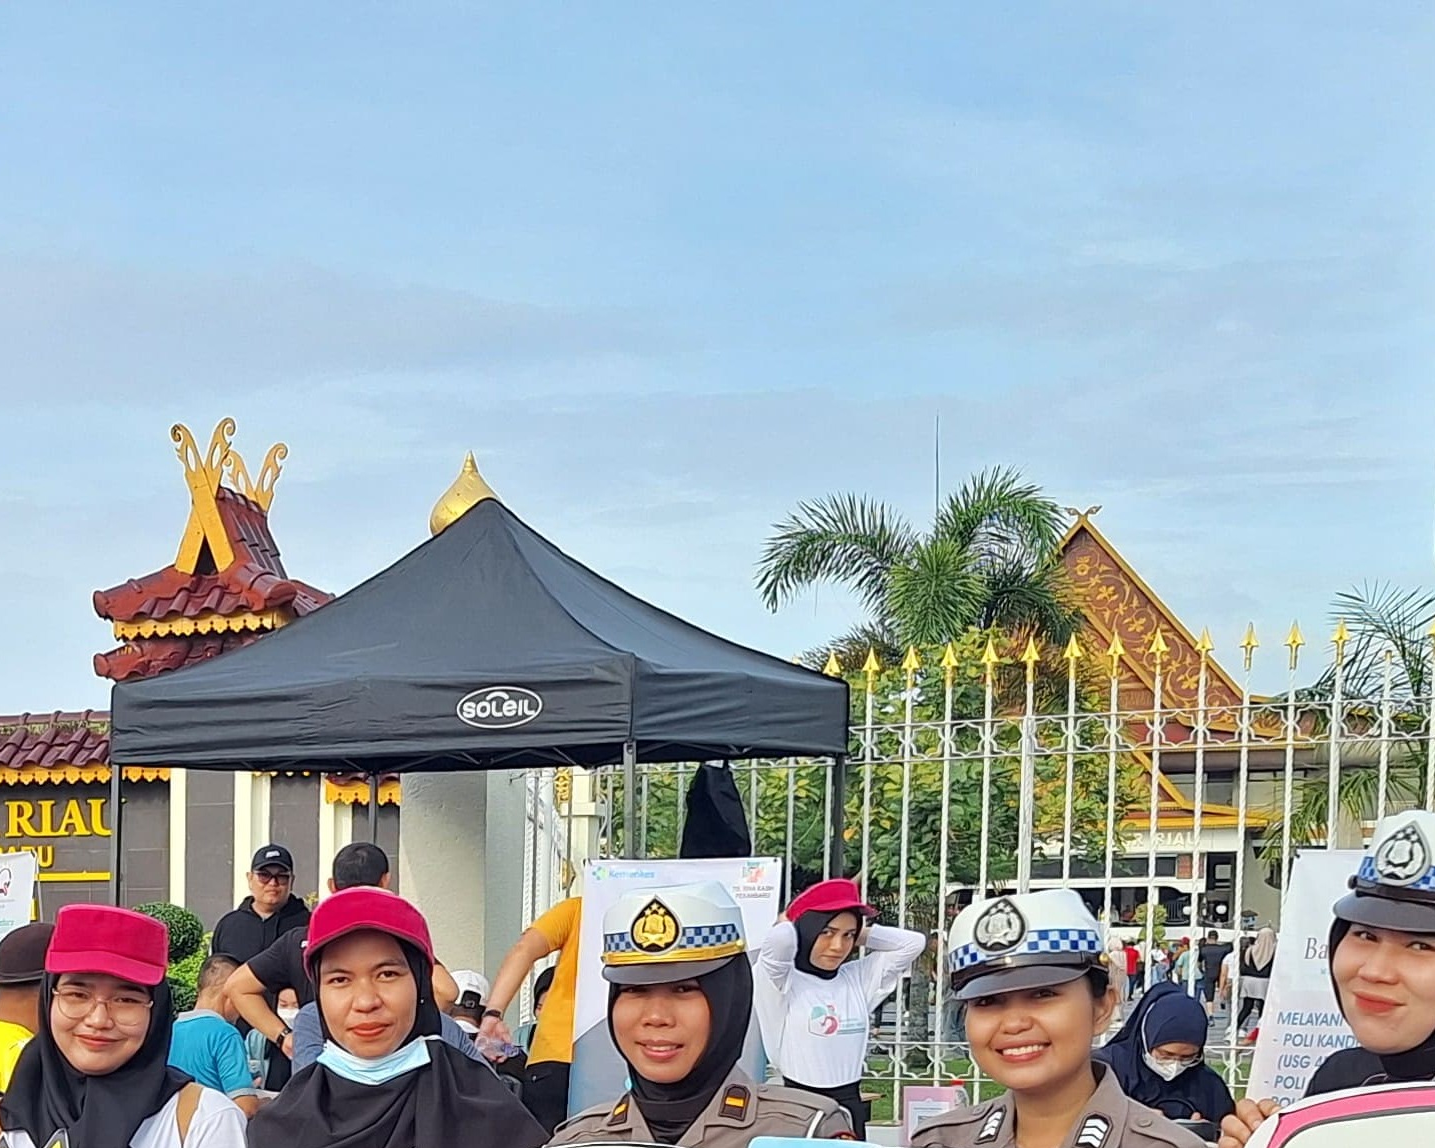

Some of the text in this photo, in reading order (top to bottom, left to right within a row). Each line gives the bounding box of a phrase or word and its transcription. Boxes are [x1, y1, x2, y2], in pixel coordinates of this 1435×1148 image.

[6, 799, 112, 837] RIAU
[1277, 1011, 1344, 1026] MELAYANI
[1283, 1033, 1314, 1047] POLI
[1277, 1054, 1311, 1070] (USG
[1274, 1075, 1305, 1090] POLI
